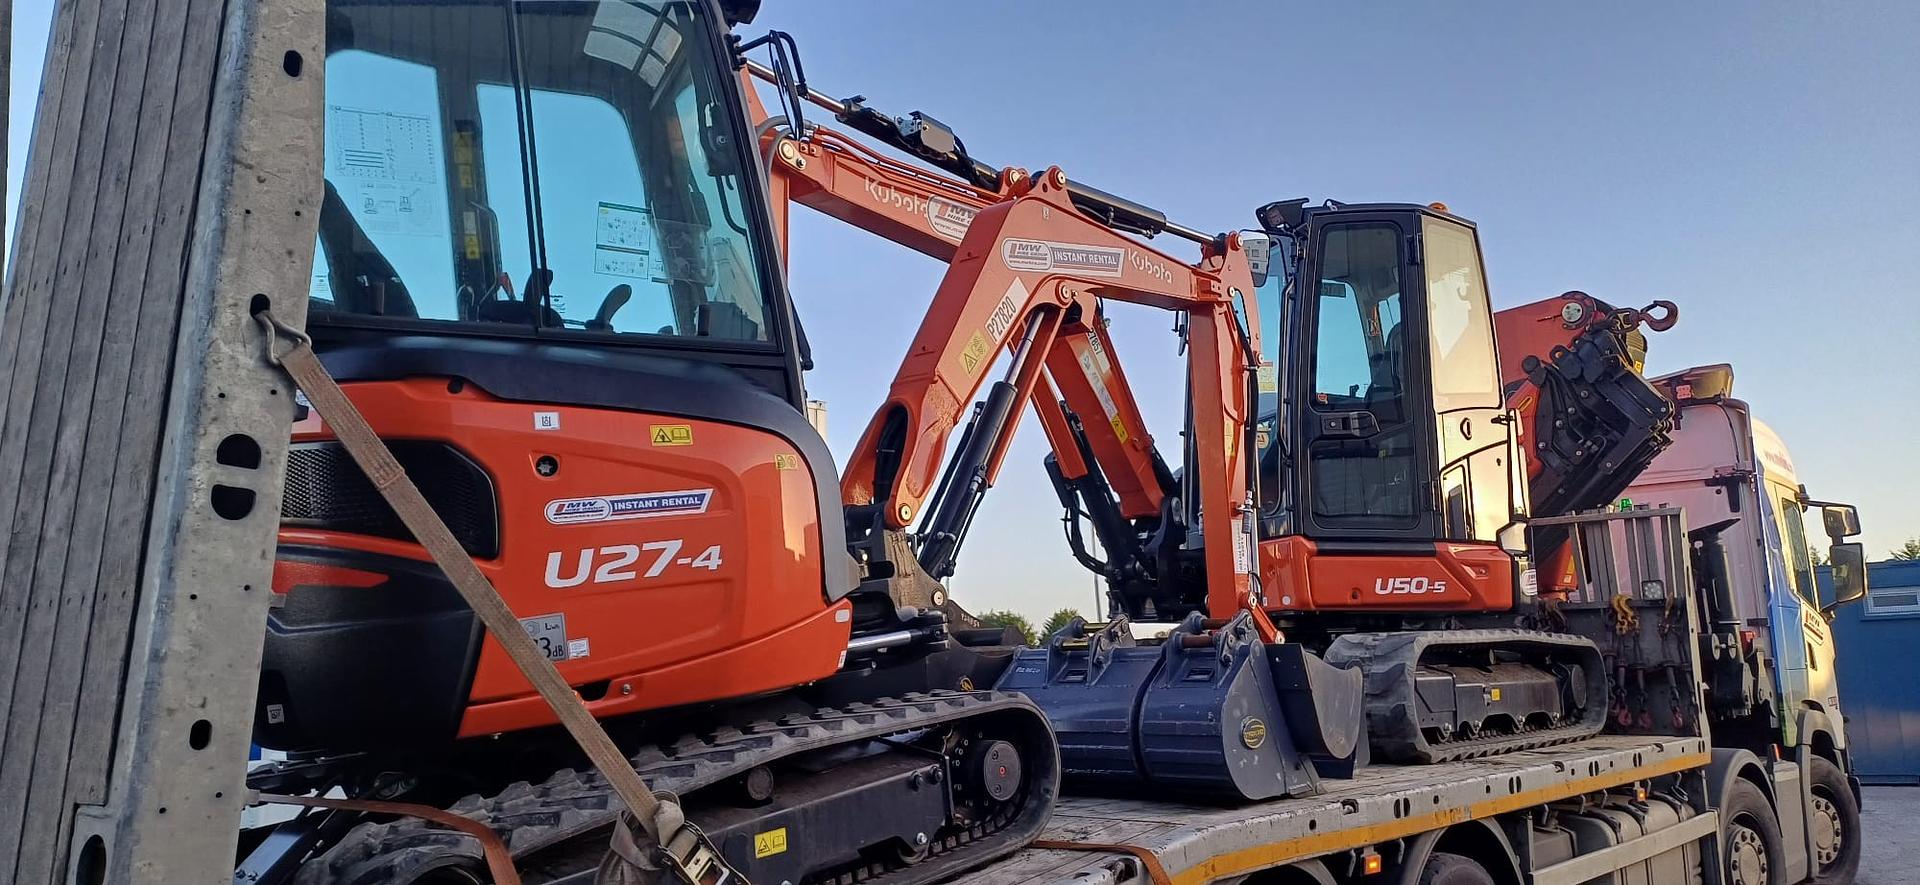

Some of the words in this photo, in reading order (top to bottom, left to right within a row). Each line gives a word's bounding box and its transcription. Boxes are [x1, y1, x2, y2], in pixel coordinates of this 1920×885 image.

[1054, 250, 1087, 263] INSTANT
[1089, 253, 1117, 265] RENTAL
[1128, 248, 1173, 285] Kubota
[986, 295, 1018, 343] P27820
[1087, 326, 1103, 356] 27857
[567, 500, 598, 509] MW
[614, 499, 659, 511] INSTANT
[661, 496, 702, 508] RENTAL
[544, 538, 723, 589] U27-4
[1374, 576, 1447, 595] U50-5
